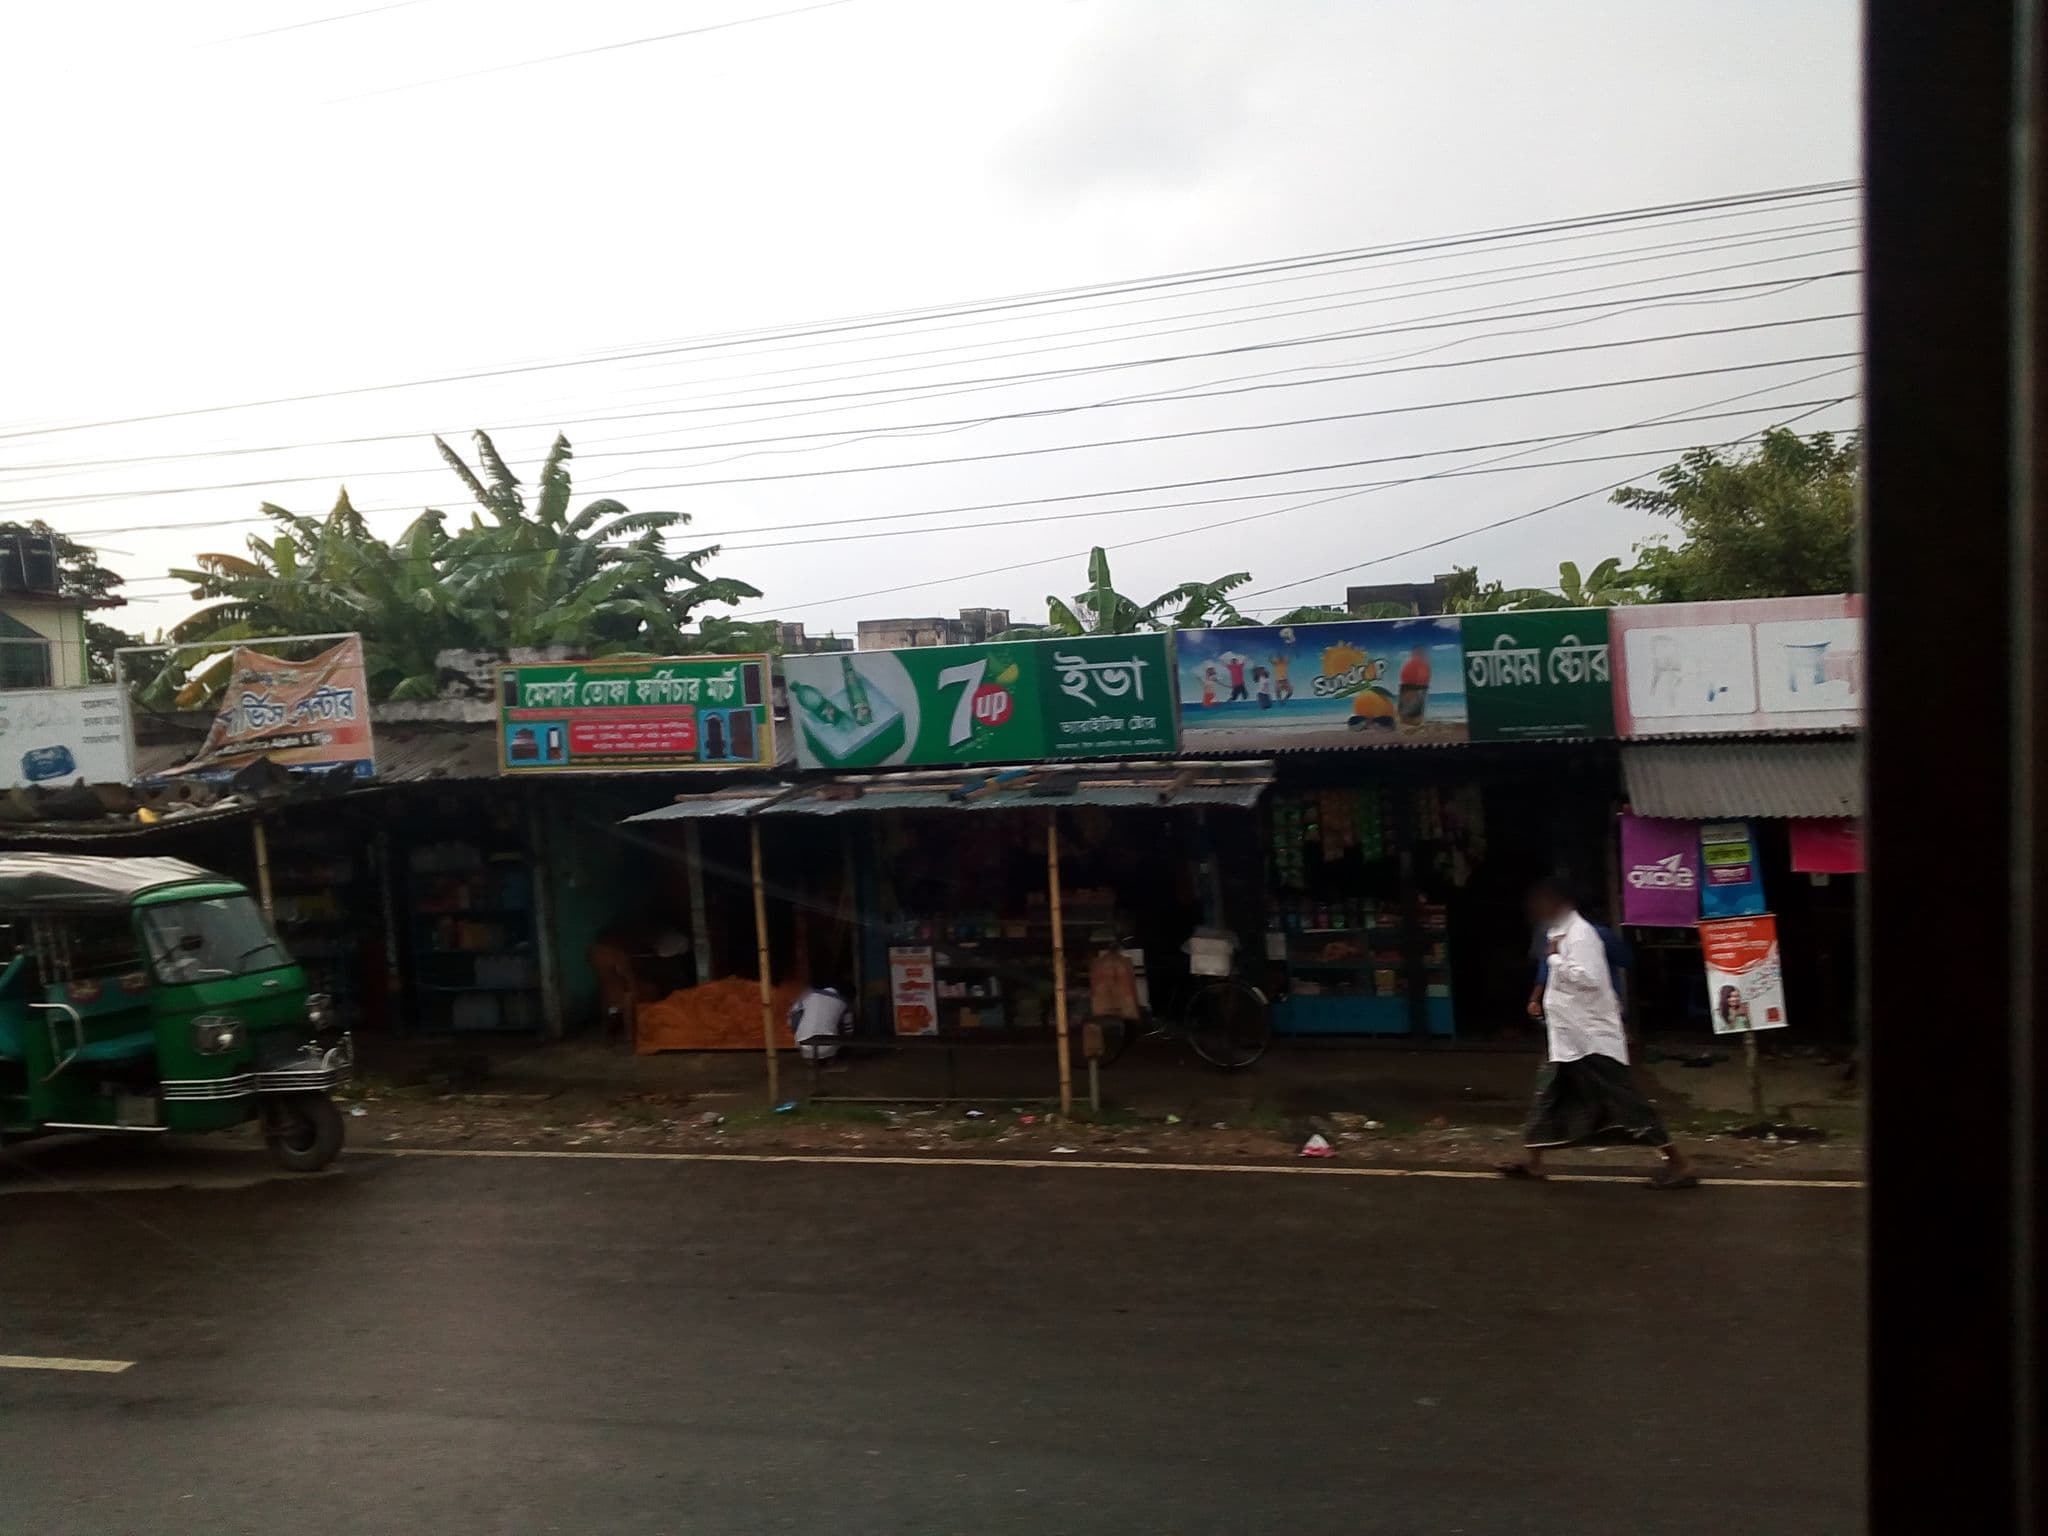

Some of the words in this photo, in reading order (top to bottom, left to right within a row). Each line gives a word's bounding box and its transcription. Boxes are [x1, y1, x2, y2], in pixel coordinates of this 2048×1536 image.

[523, 671, 579, 708] মেসার্স
[706, 667, 738, 701] মার্ট
[1053, 650, 1149, 708] ইভা
[1465, 634, 1542, 688] তামিম
